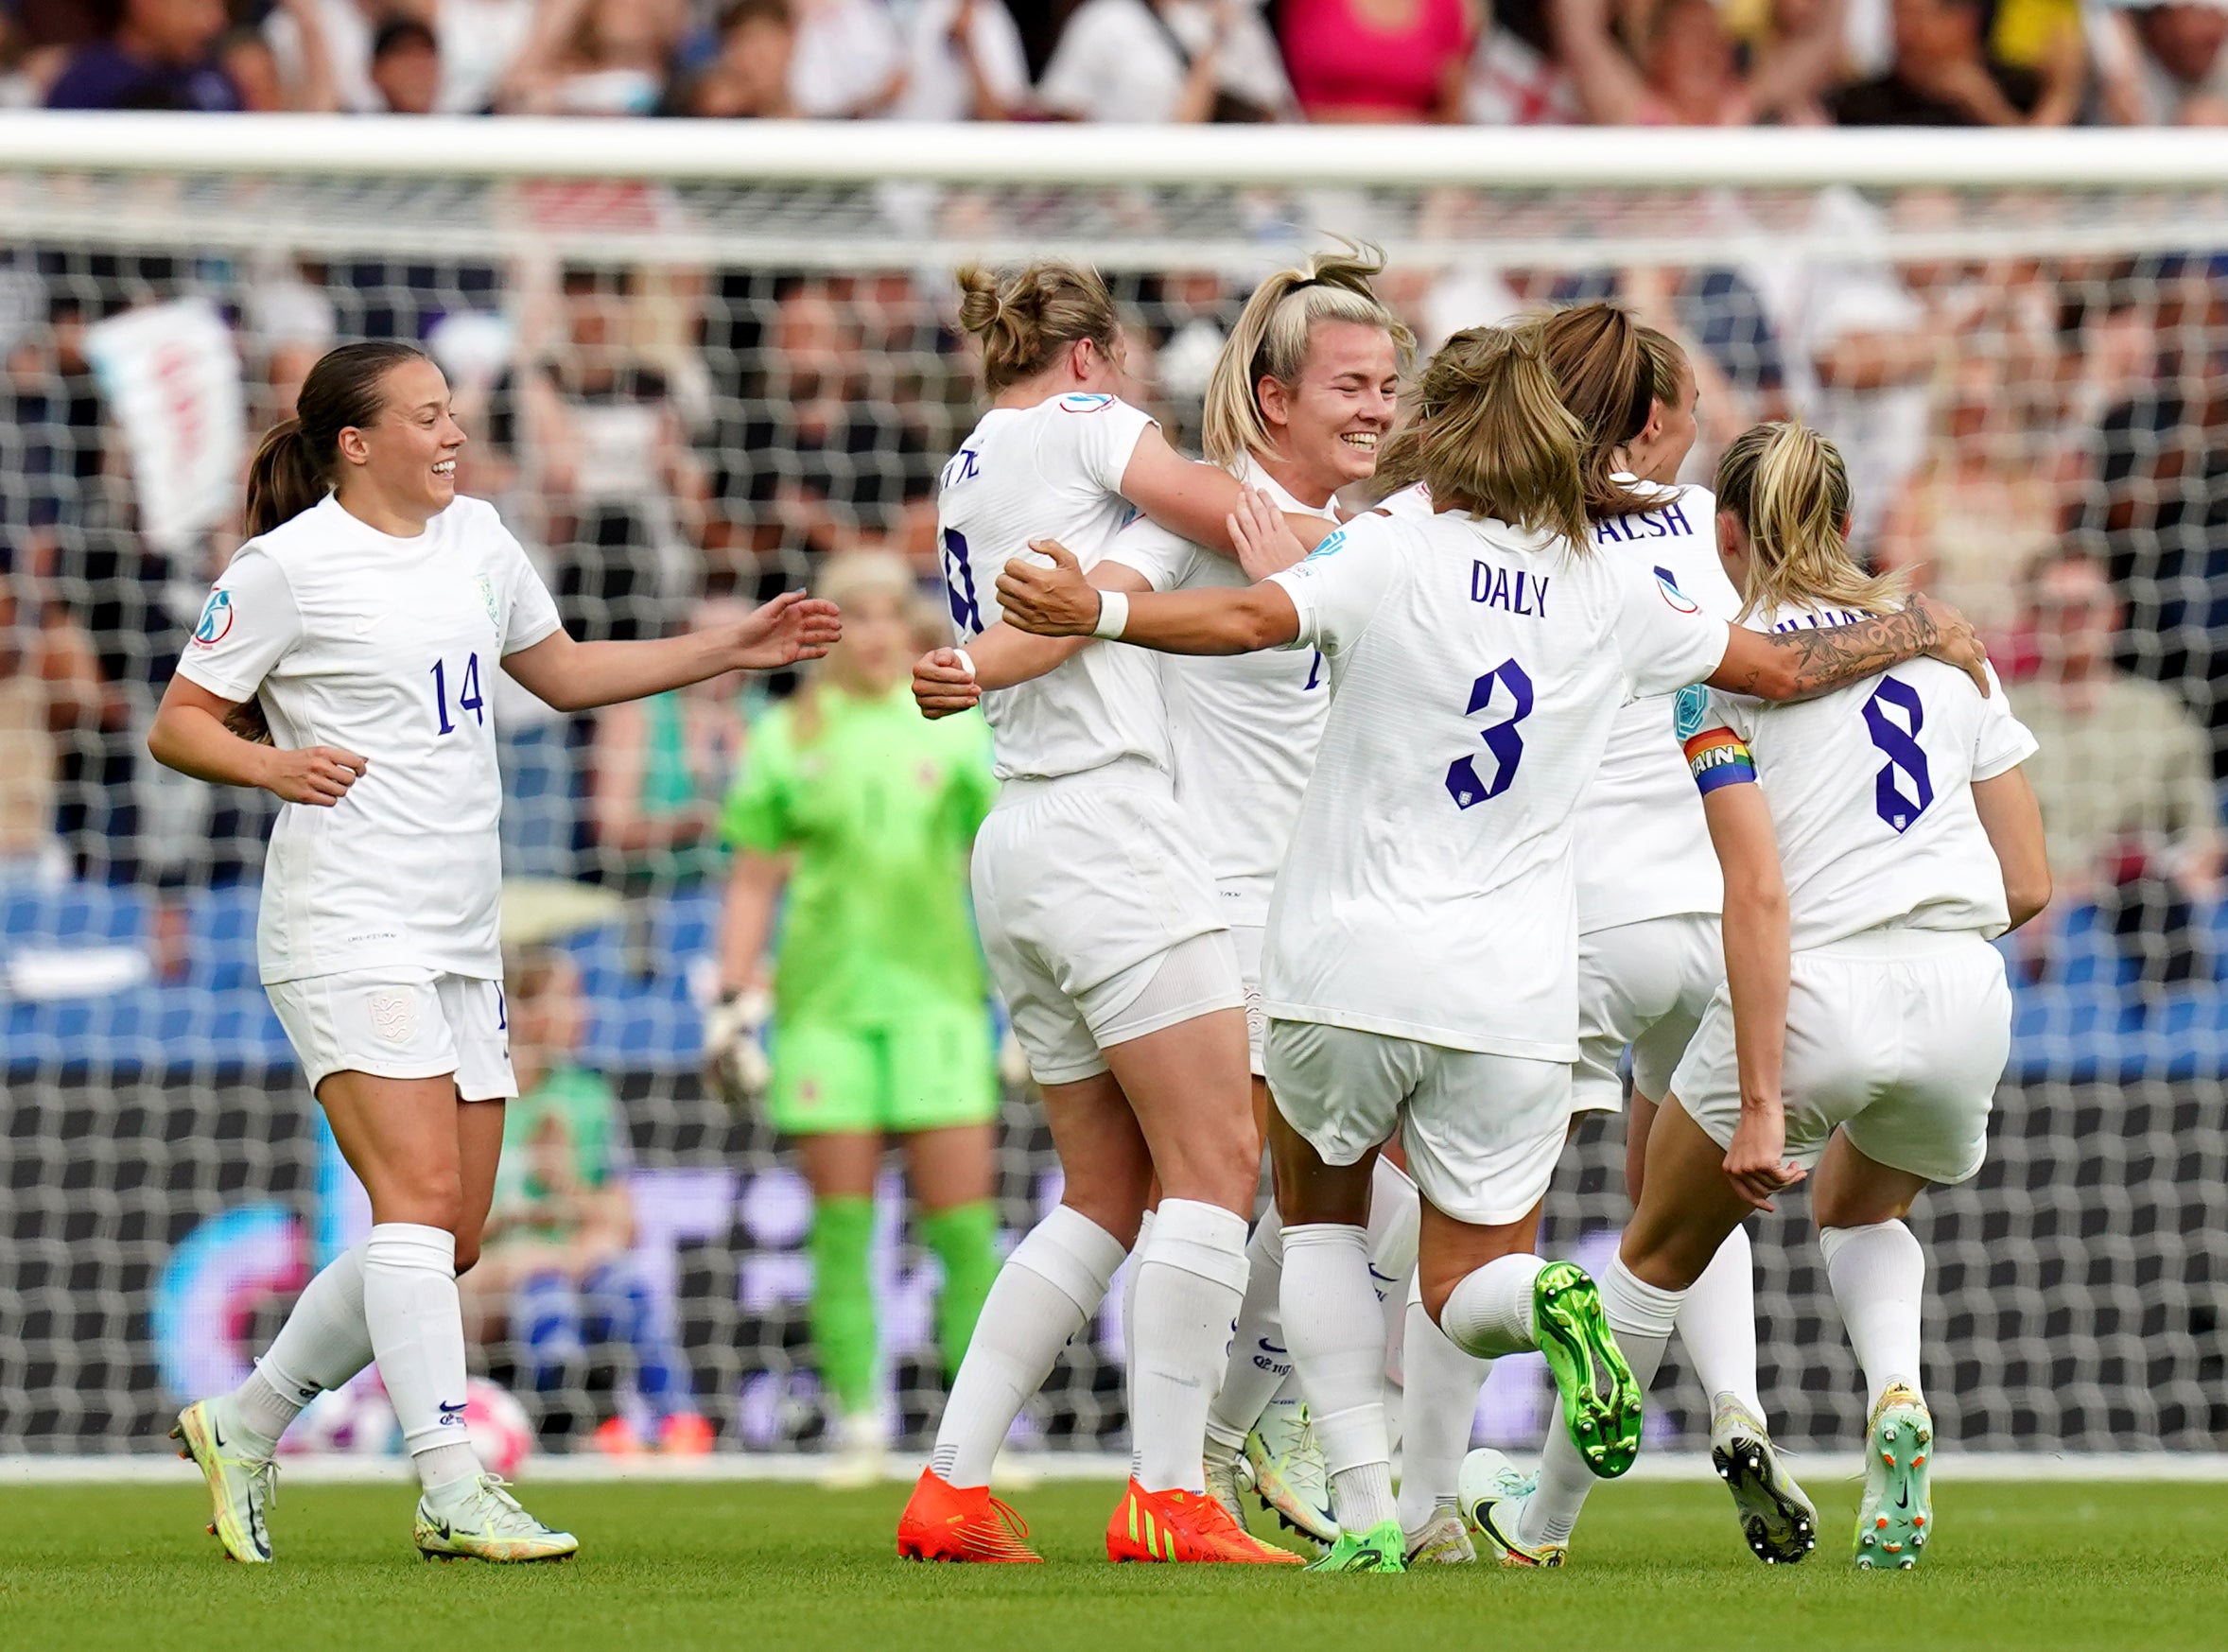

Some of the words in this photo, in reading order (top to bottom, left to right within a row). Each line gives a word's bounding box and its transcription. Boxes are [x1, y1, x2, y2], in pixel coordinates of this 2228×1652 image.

[1596, 502, 1694, 545] ALSH
[1471, 559, 1549, 617] DALY
[429, 652, 483, 736] 14
[1445, 658, 1534, 810] 3
[1690, 745, 1735, 779] TAIN
[1861, 674, 1934, 834] 8
